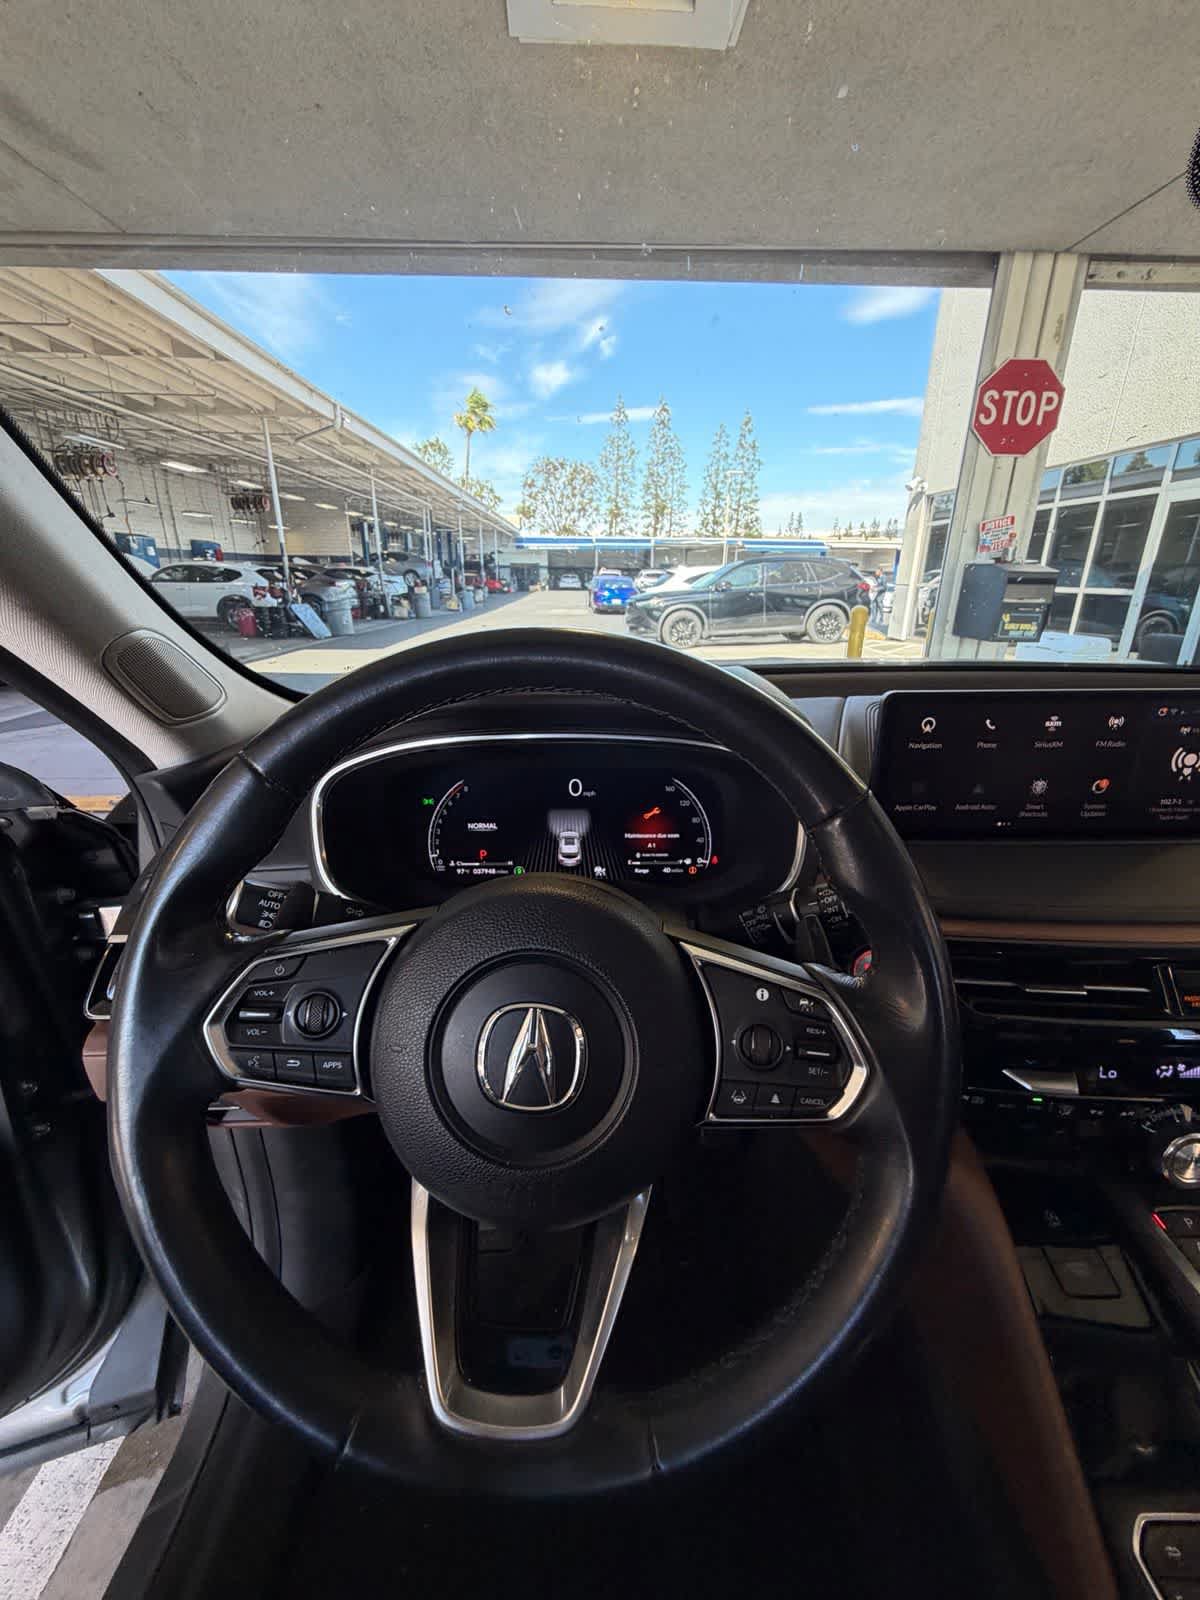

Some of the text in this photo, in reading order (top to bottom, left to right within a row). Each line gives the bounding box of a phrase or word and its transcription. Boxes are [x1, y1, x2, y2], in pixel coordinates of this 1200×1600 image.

[979, 389, 1059, 426] STOP
[909, 742, 942, 750] Navigation
[977, 741, 997, 749] Phone
[569, 778, 582, 796] 0
[480, 850, 487, 860] P
[268, 890, 284, 899] OFF
[258, 900, 281, 909] AUTO
[322, 1061, 343, 1069] APPS
[1099, 1065, 1118, 1079] Lo
[800, 1098, 825, 1106] CANCEL
